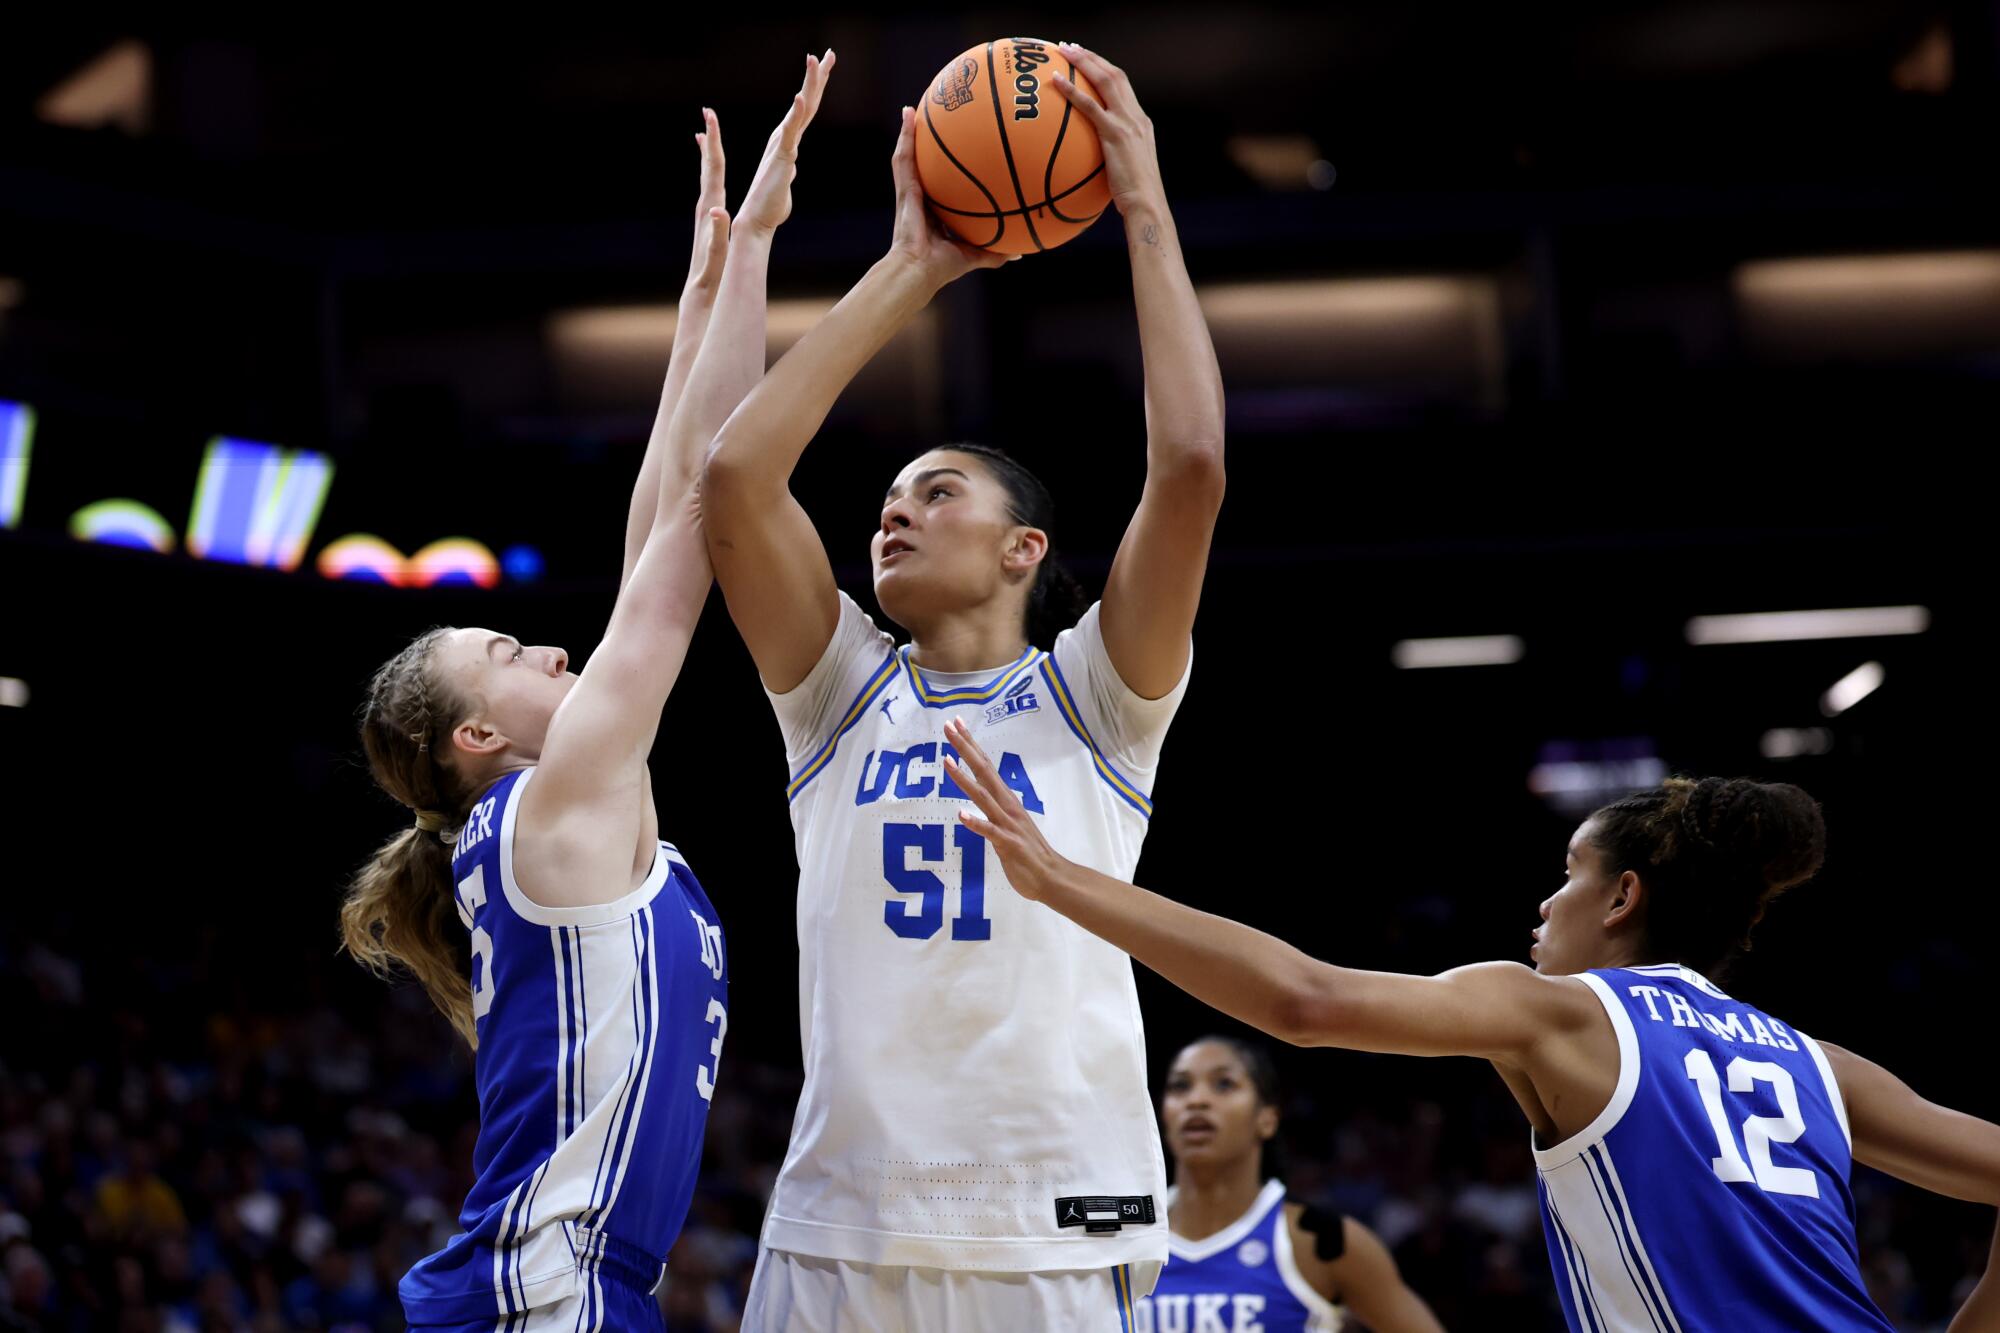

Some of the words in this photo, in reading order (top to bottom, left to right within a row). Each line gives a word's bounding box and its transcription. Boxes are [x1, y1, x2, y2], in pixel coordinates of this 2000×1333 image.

[1011, 37, 1049, 121] ilson
[883, 823, 991, 940] 51
[1684, 1048, 1820, 1199] 12
[1123, 1204, 1139, 1215] 50
